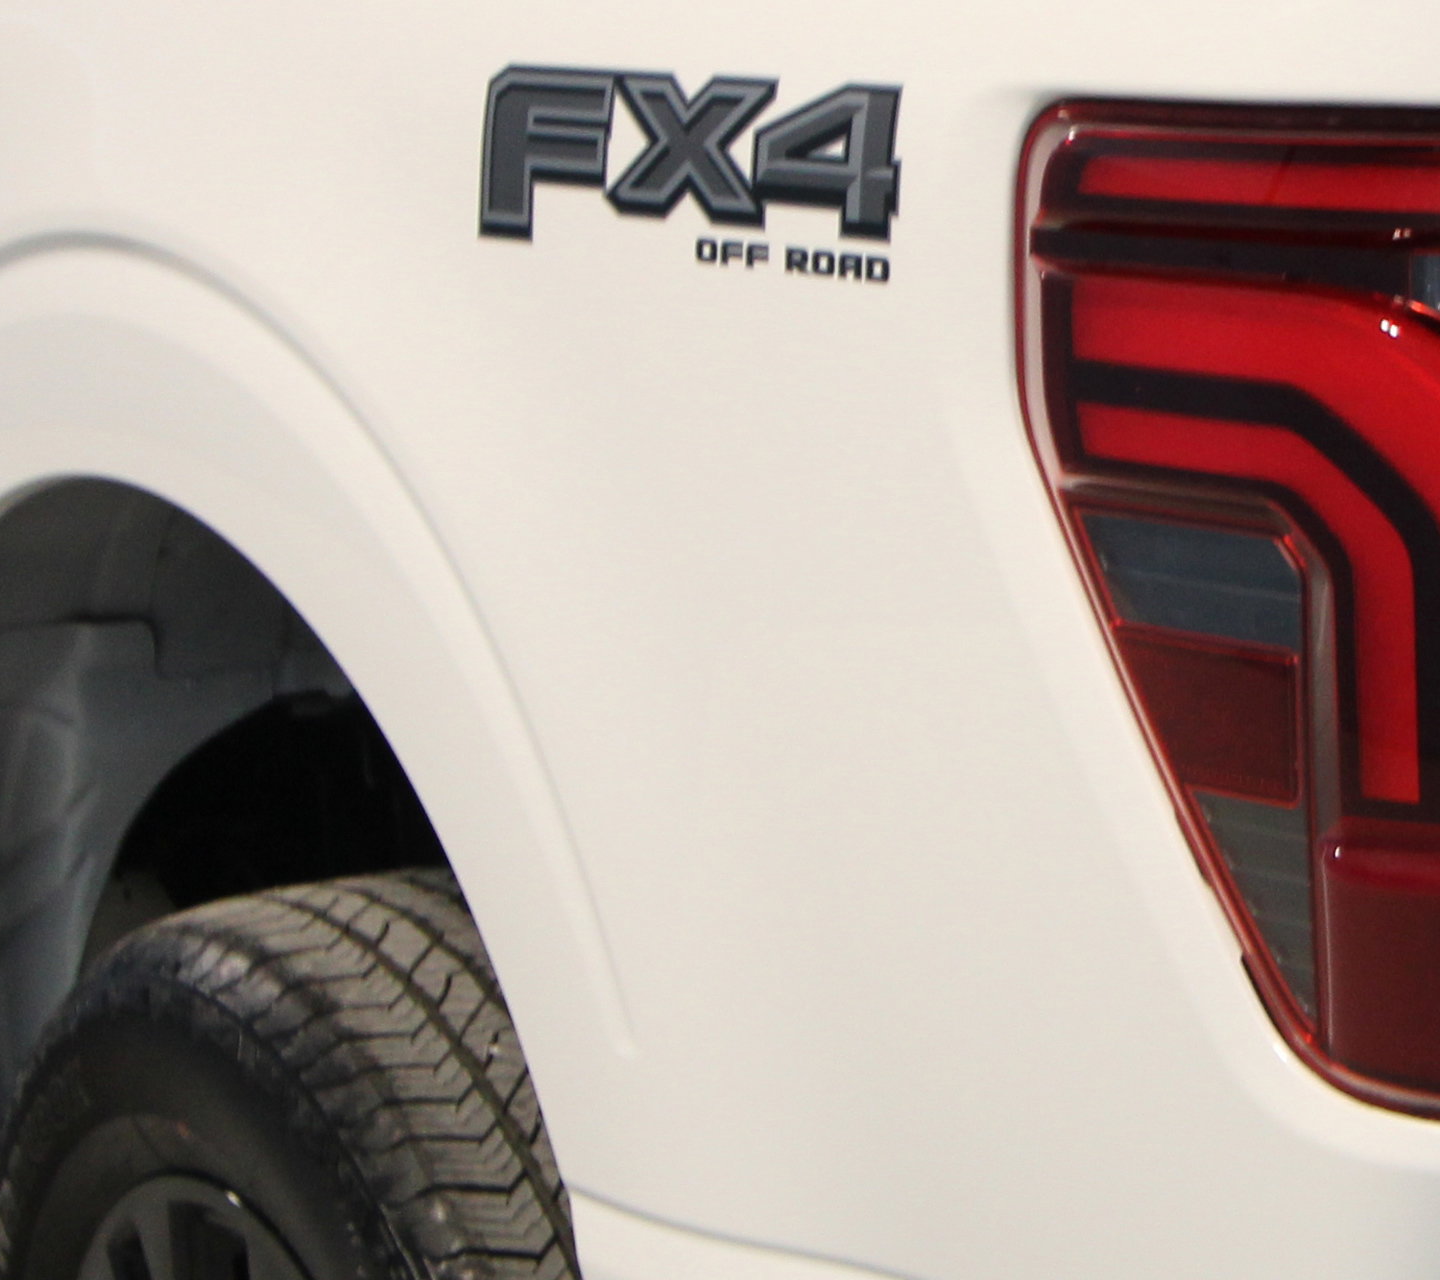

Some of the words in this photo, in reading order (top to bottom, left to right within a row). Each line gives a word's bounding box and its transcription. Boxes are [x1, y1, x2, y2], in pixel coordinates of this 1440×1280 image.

[478, 62, 903, 245] FX4
[696, 236, 770, 269] OFF
[784, 245, 891, 284] ROAD
